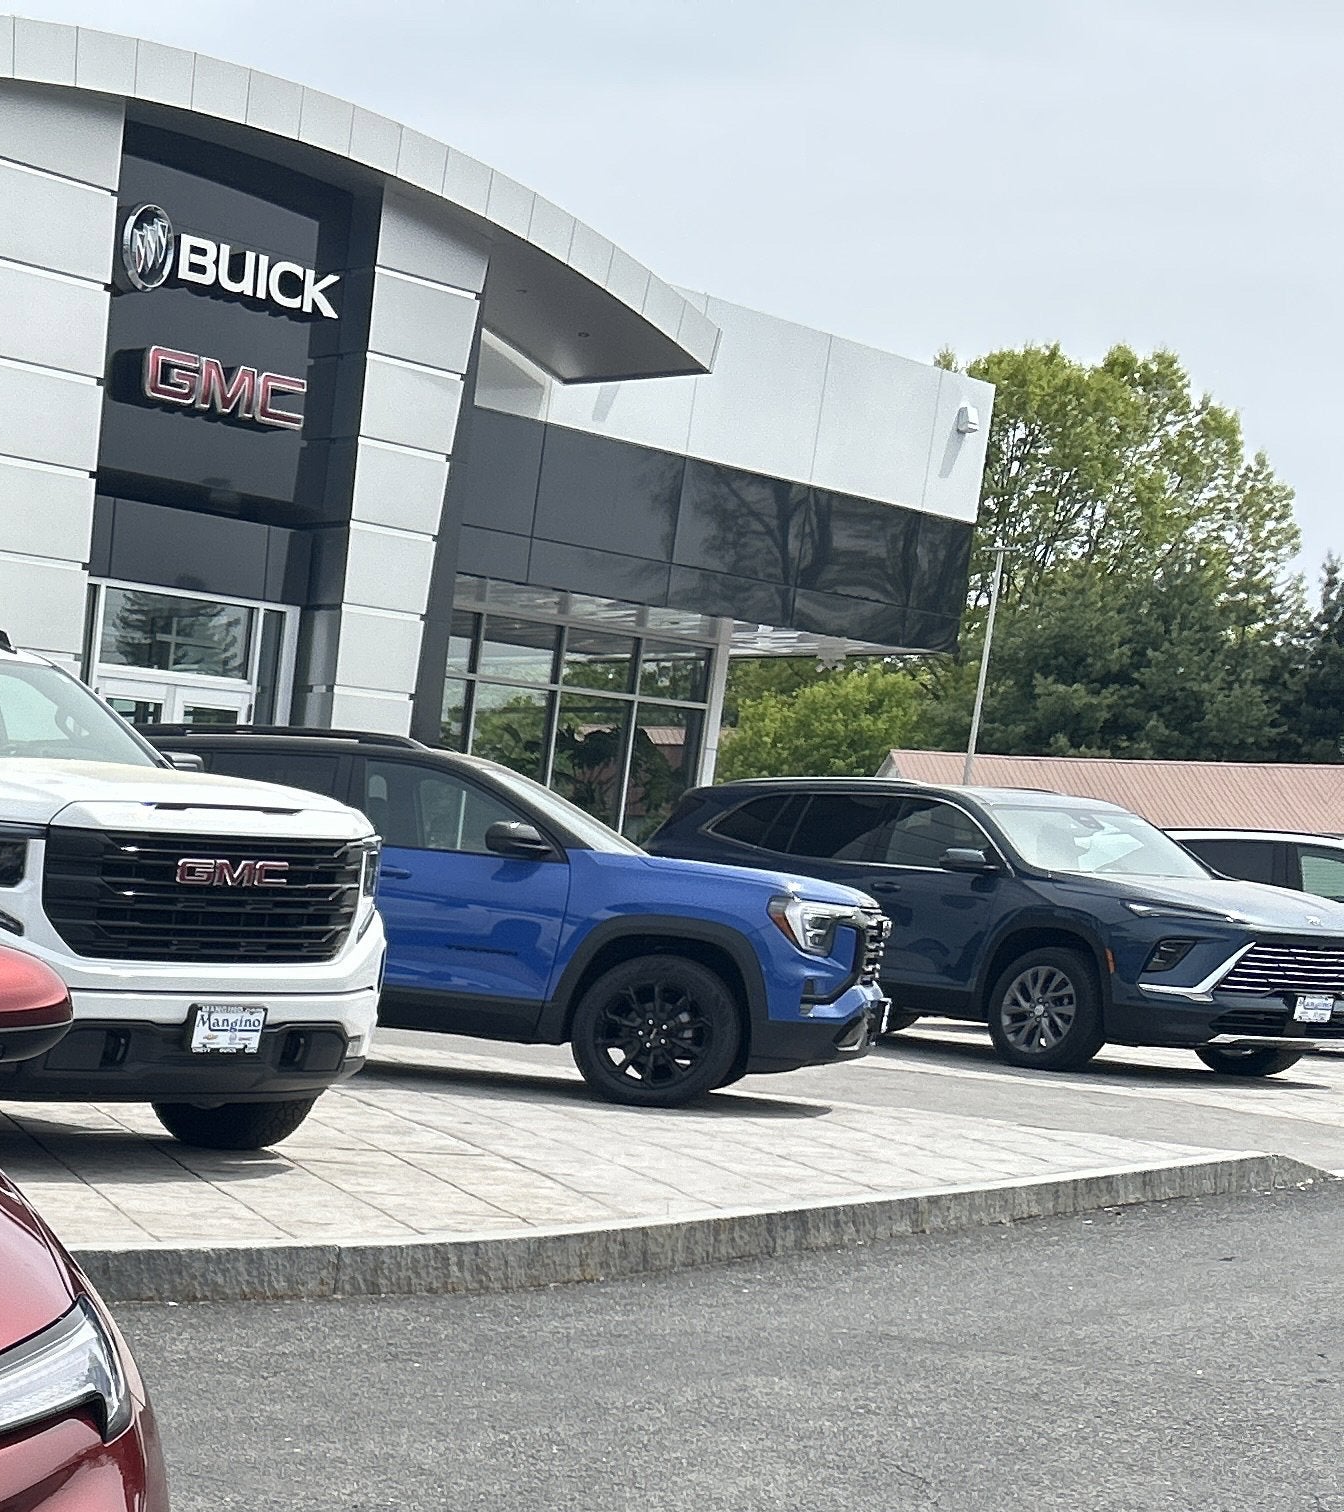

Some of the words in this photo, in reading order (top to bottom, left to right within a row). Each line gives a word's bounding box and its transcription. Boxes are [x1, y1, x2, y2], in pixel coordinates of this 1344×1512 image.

[177, 232, 340, 320] BUICK
[143, 344, 308, 431] GMC
[175, 857, 289, 888] GMC
[196, 1013, 262, 1033] Mangino
